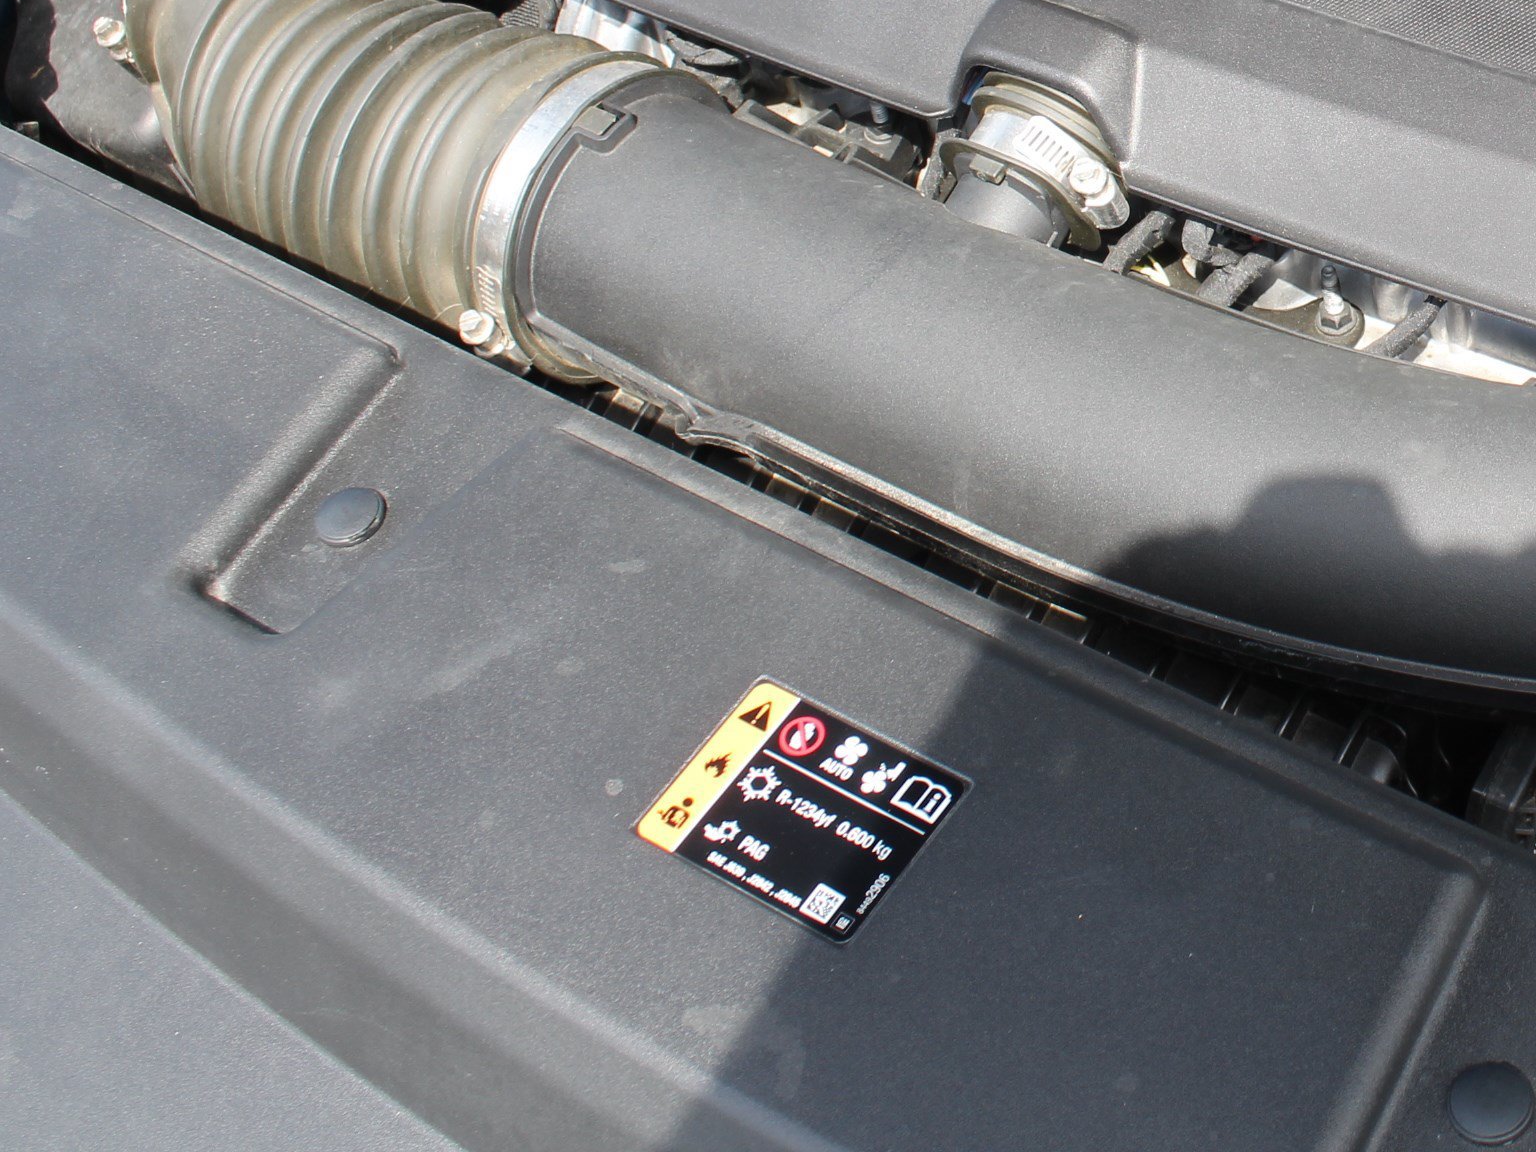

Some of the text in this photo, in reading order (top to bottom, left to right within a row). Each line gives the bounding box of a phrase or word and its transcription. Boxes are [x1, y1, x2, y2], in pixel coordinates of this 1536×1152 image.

[819, 757, 854, 781] AUTO
[775, 788, 893, 861] R-1234yf 0.600 kg
[737, 835, 771, 862] PAG
